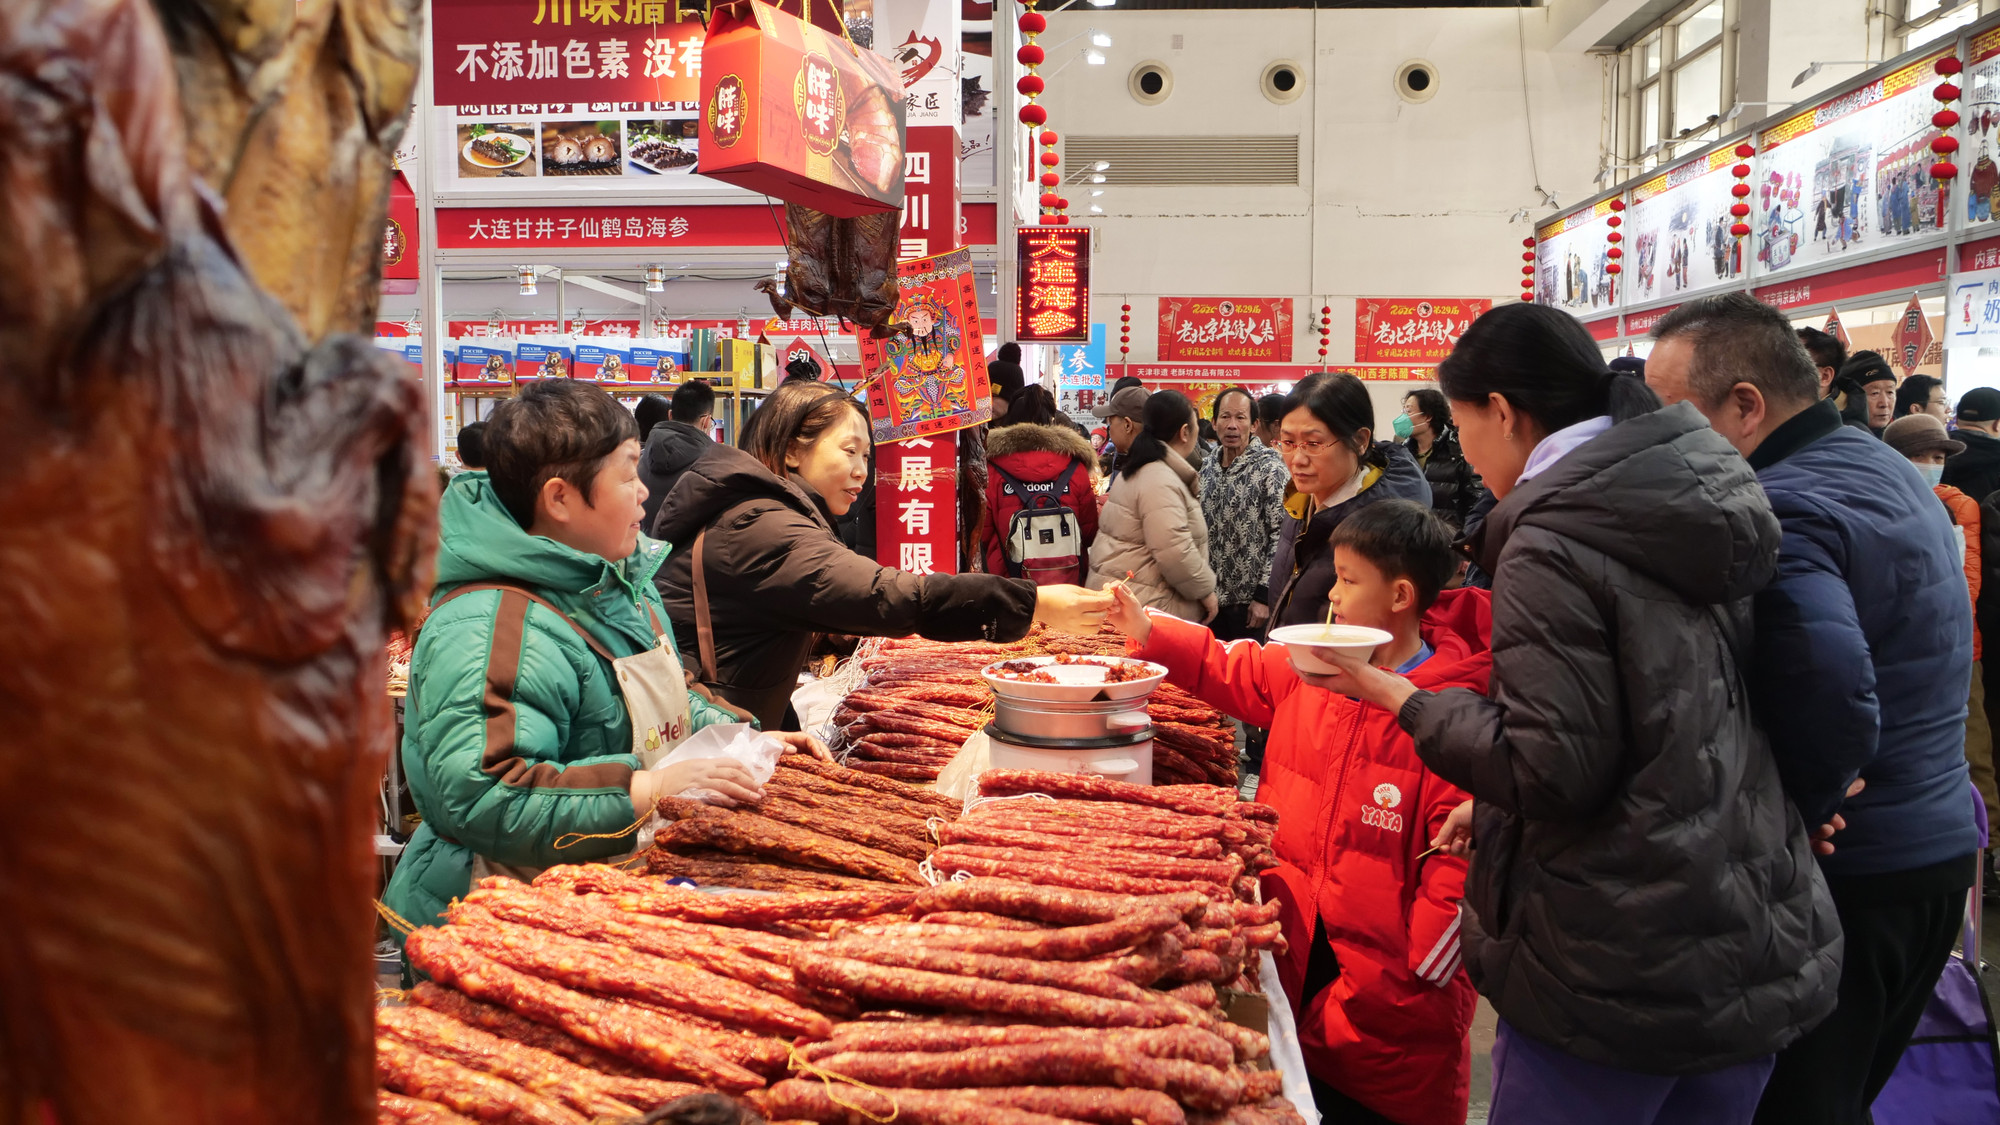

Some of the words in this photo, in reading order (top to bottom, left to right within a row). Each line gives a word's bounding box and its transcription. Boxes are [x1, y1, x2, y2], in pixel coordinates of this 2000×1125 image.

[456, 39, 630, 82] 不添加色素
[468, 216, 690, 240] 大连甘井子仙鹤岛海参
[1937, 257, 1944, 274] 7
[1176, 317, 1275, 345] 老北京年货大集
[1903, 308, 1921, 369] 南京
[1059, 374, 1102, 386] 大连批发
[1137, 368, 1168, 377] 天津非遗
[1170, 368, 1241, 377] 老酥坊食品有限公司
